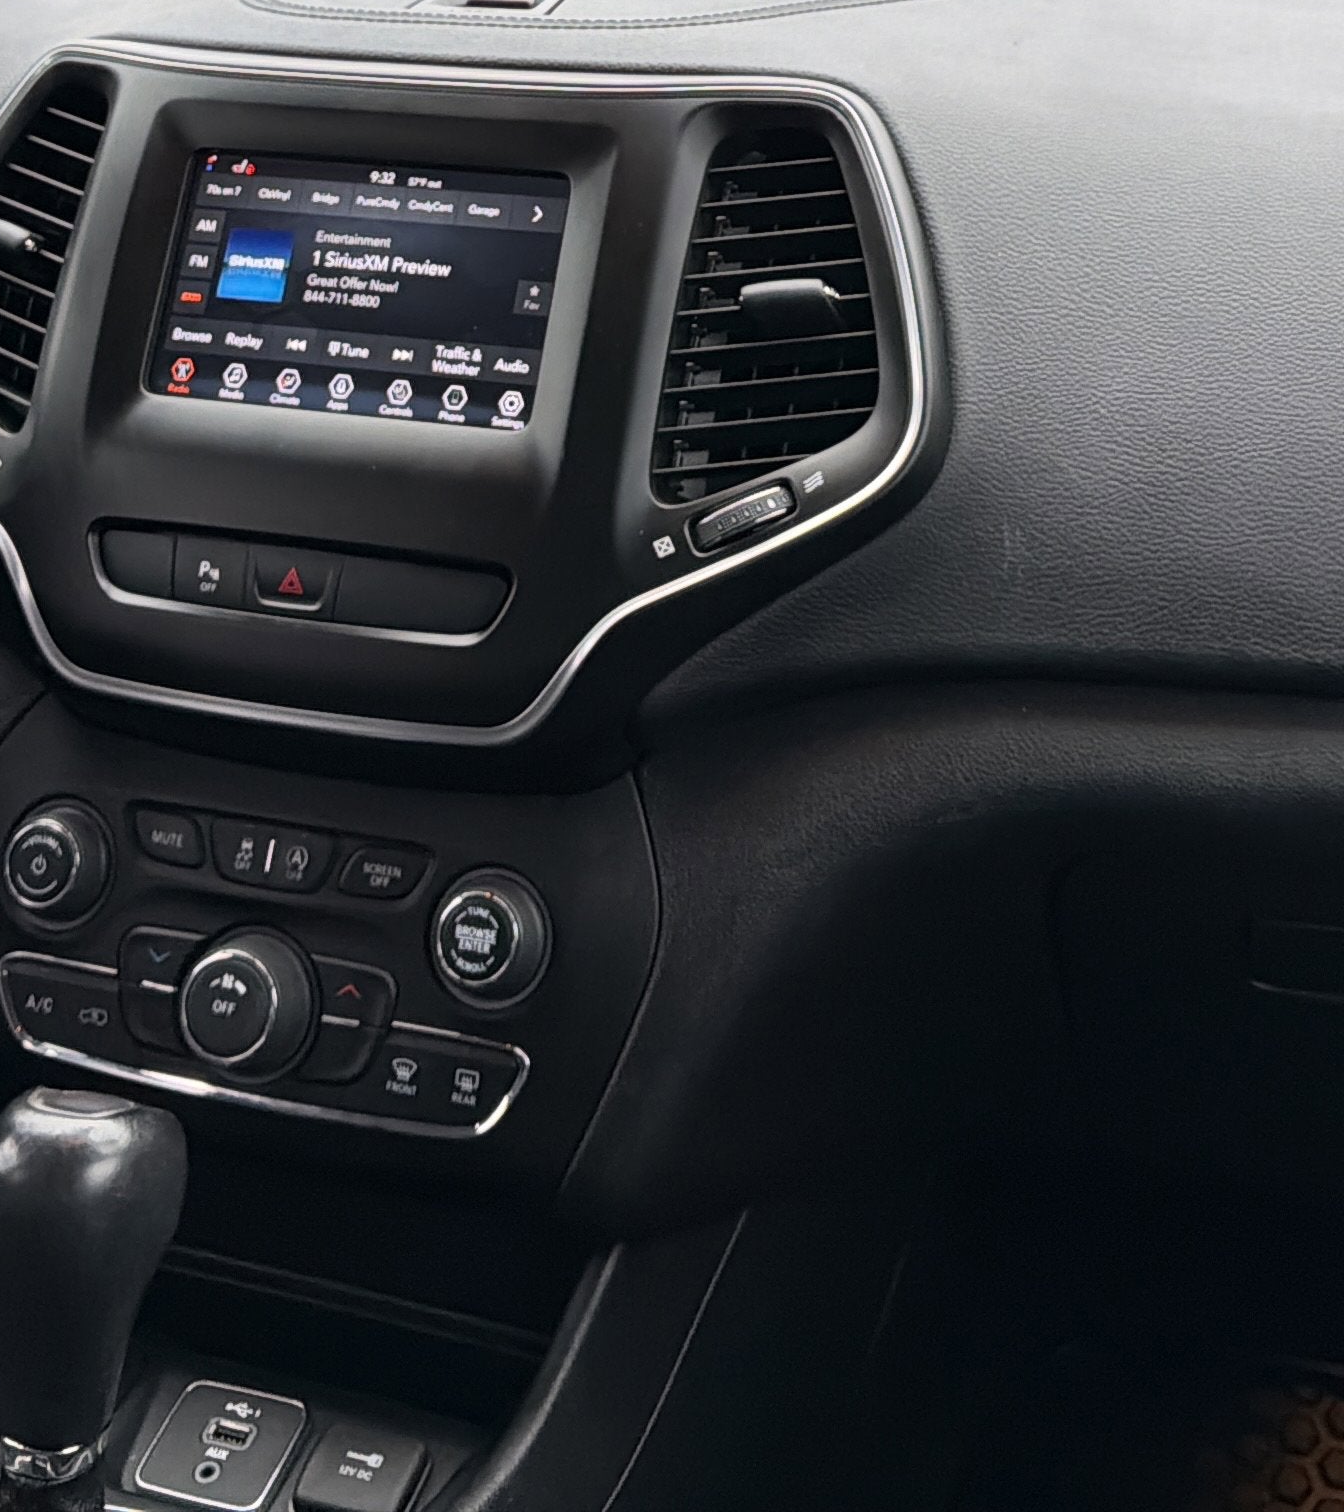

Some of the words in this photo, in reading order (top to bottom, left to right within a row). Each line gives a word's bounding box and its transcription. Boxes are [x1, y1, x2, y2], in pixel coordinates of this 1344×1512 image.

[369, 170, 396, 185] 9:32
[467, 203, 501, 218] Garage
[195, 218, 217, 233] AM
[316, 229, 392, 248] Entertainment
[188, 254, 209, 268] FM
[228, 254, 286, 271] SiriusXM
[312, 250, 321, 267] 1
[325, 250, 390, 273] SiriusXM
[392, 256, 452, 278] Preview
[306, 273, 337, 288] Great
[339, 275, 367, 290] Offer
[369, 278, 399, 293] Now!
[302, 290, 380, 309] 844-711-8800
[523, 299, 540, 311] Fav
[171, 326, 213, 344] Browse
[224, 331, 263, 351] Replay
[341, 343, 370, 359] Tune
[435, 344, 470, 361] Traffic
[471, 348, 482, 363] &
[431, 359, 480, 377] Weather
[493, 357, 530, 374] Audio
[326, 399, 349, 411] Apps
[437, 410, 466, 423] Phone
[151, 829, 184, 849] MUTE
[234, 859, 252, 871] OFF
[362, 861, 402, 880] SCREEN
[369, 874, 391, 888] OFF
[467, 906, 490, 919] TUNE
[455, 923, 497, 940] BROWSE
[457, 939, 491, 955] ENTER
[455, 955, 488, 973] SCROLL
[24, 993, 54, 1015] A/C
[212, 998, 237, 1017] OFF
[386, 1080, 417, 1096] FRONT
[451, 1091, 477, 1107] REAR
[204, 1446, 230, 1461] AUX
[338, 1464, 357, 1477] 12V
[356, 1468, 373, 1482] DC
